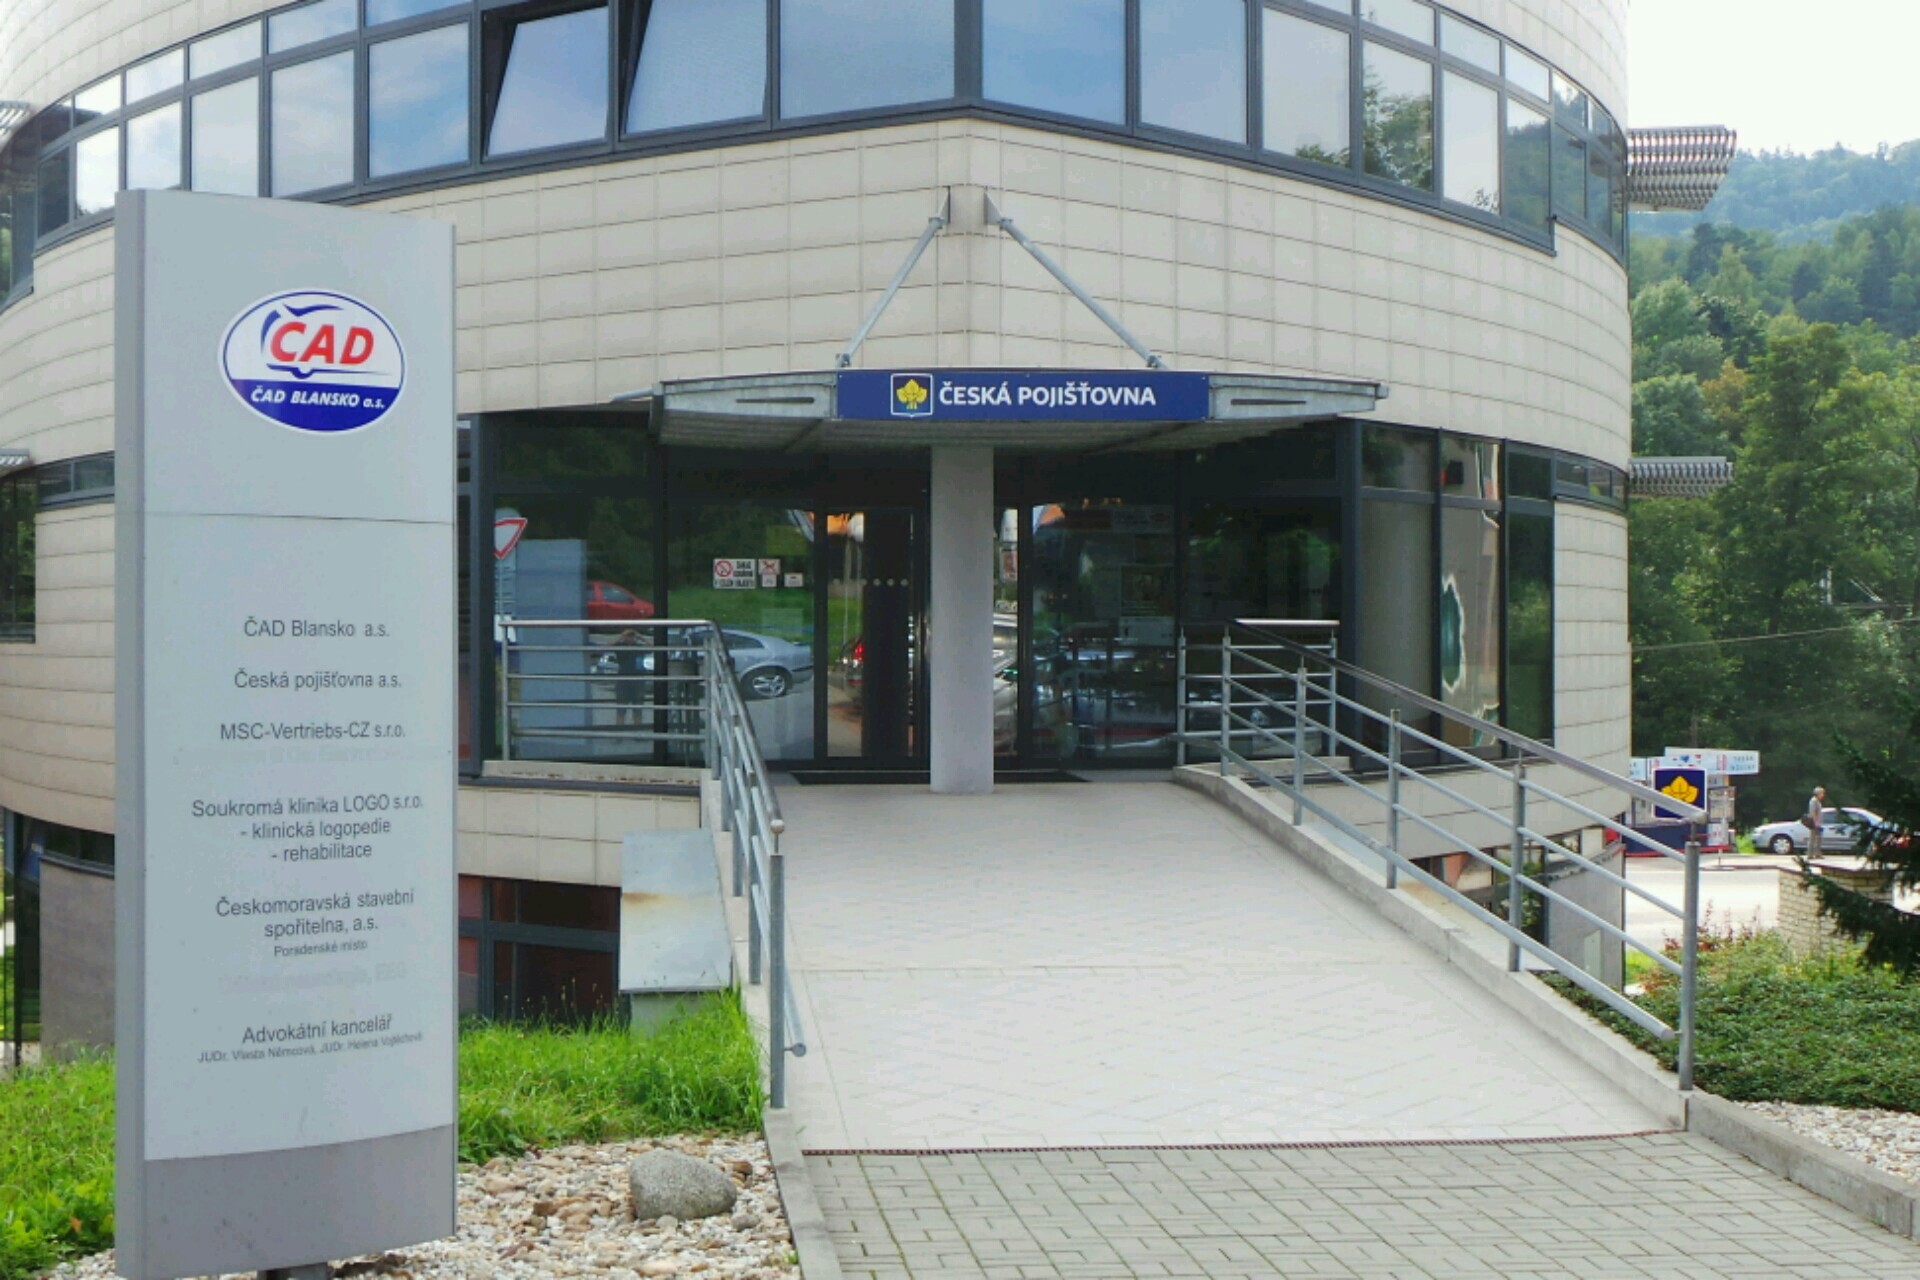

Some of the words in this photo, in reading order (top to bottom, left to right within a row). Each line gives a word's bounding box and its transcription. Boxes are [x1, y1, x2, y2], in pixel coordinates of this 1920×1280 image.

[251, 386, 286, 403] ČAD
[290, 391, 360, 407] BLANSKO
[363, 398, 385, 409] a.s.
[938, 381, 1012, 406] ČESKÁ
[1018, 381, 1157, 408] POJIŠŤOVNA
[244, 616, 285, 637] ČAD
[291, 619, 356, 637] Blansko
[364, 623, 390, 637] a.s.
[234, 667, 290, 688] Česká
[295, 671, 374, 692] pojišťovna
[378, 675, 402, 688] a.s.
[220, 721, 370, 740] MSC-Vertriebs-CZ
[374, 724, 406, 738] s.r.o.
[191, 799, 283, 818] Soukromá
[288, 798, 338, 815] klinika
[343, 793, 390, 812] LOGO
[393, 795, 423, 810] s.r.o.
[252, 820, 315, 840] klinická
[319, 817, 391, 840] logopedie
[283, 843, 373, 862] rehabilitace
[216, 892, 350, 917] Českomoravská
[356, 887, 415, 909] stavební
[264, 917, 349, 940] spořitelna,
[353, 916, 379, 932] a.s.
[274, 940, 338, 957] Poradenské
[242, 1021, 326, 1044] Advokátní
[331, 1013, 392, 1037] kancelář
